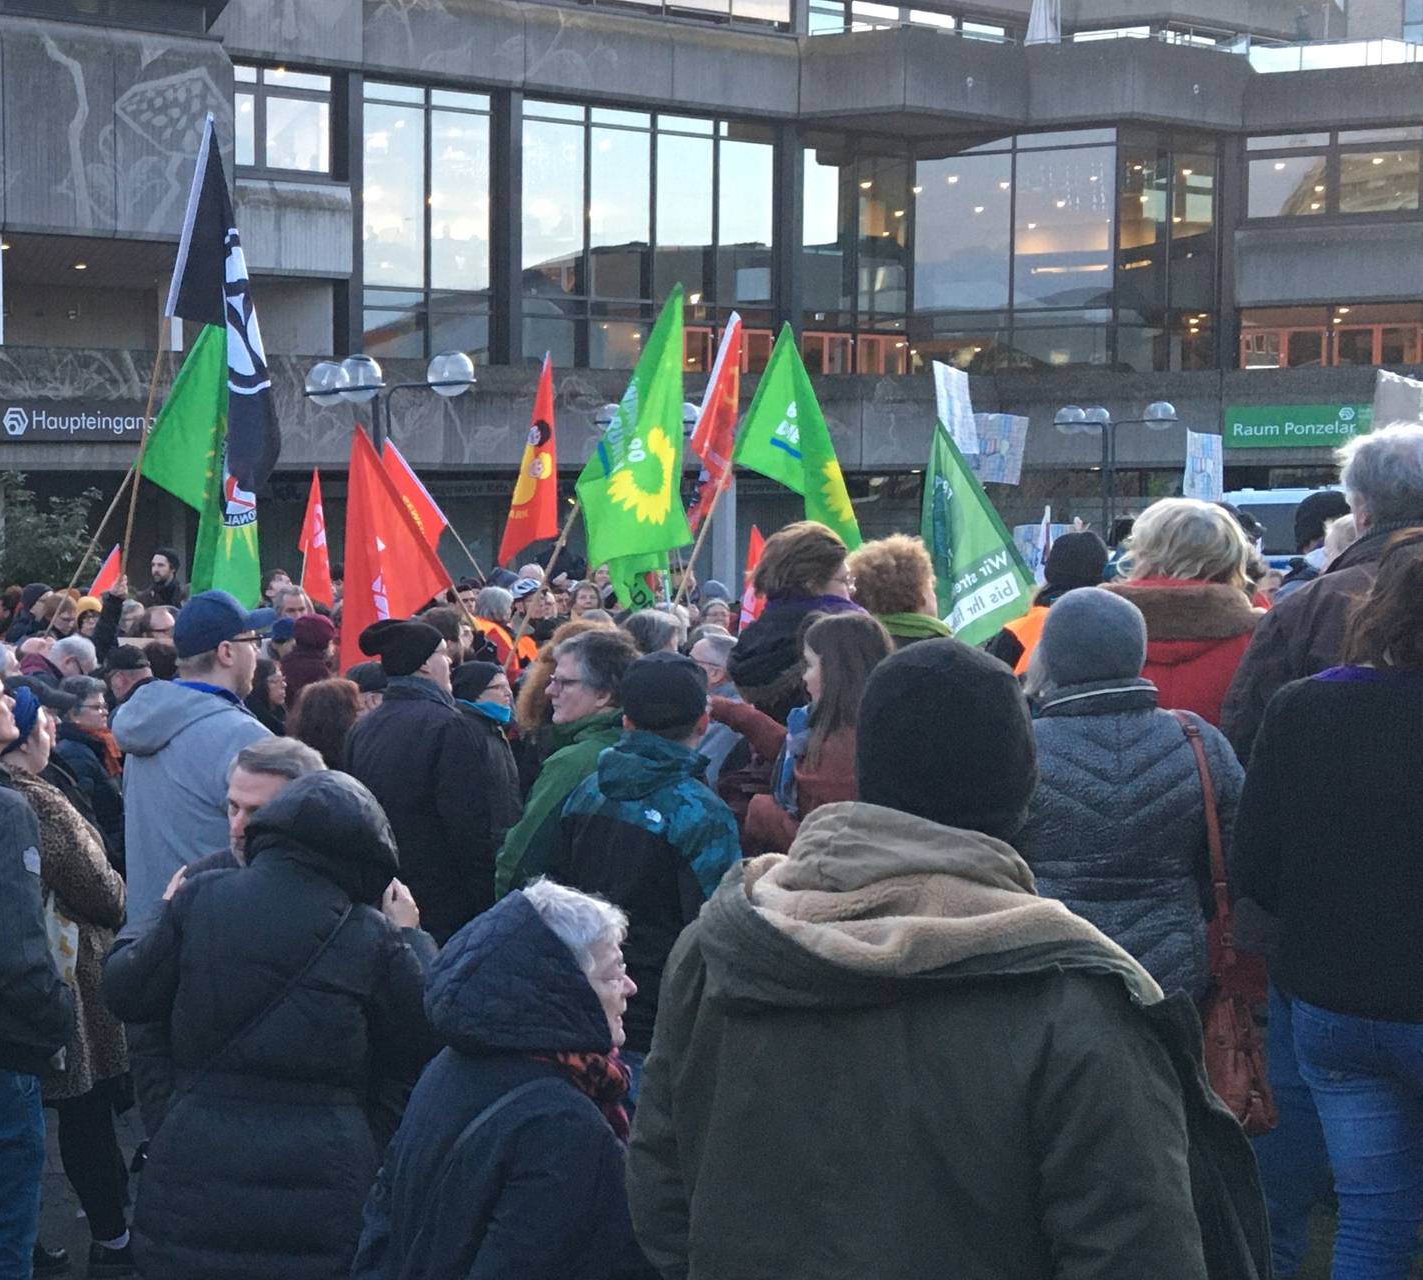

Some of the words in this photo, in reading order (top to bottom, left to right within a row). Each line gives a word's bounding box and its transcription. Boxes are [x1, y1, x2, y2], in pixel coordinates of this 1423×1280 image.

[32, 410, 157, 435] Haupteingang
[1233, 423, 1280, 436] Raum
[1284, 420, 1356, 436] Ponzelar
